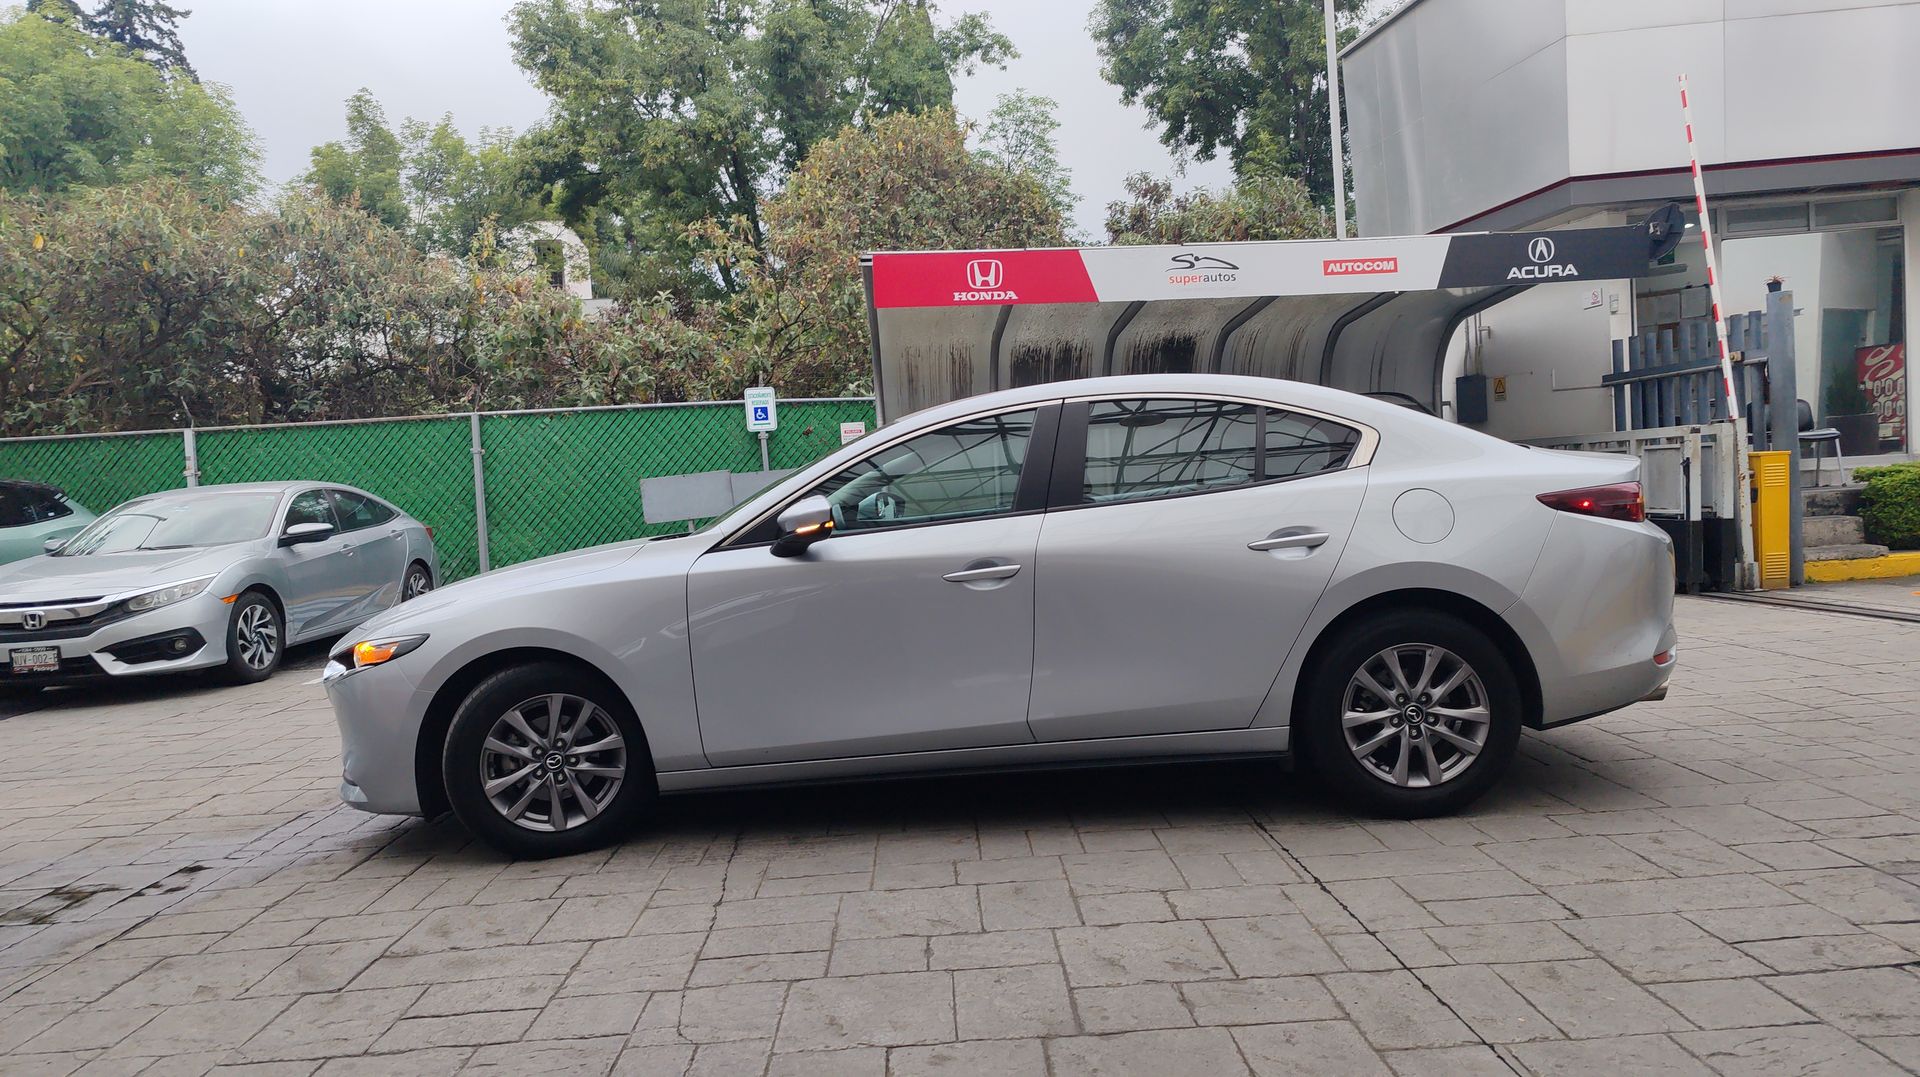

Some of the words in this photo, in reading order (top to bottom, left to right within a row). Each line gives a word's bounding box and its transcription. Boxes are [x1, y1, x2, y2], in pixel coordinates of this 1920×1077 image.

[1327, 260, 1395, 273] AUTOCOM
[1506, 263, 1579, 280] ACURA
[1168, 272, 1237, 286] superautos
[953, 290, 1019, 301] HONDA
